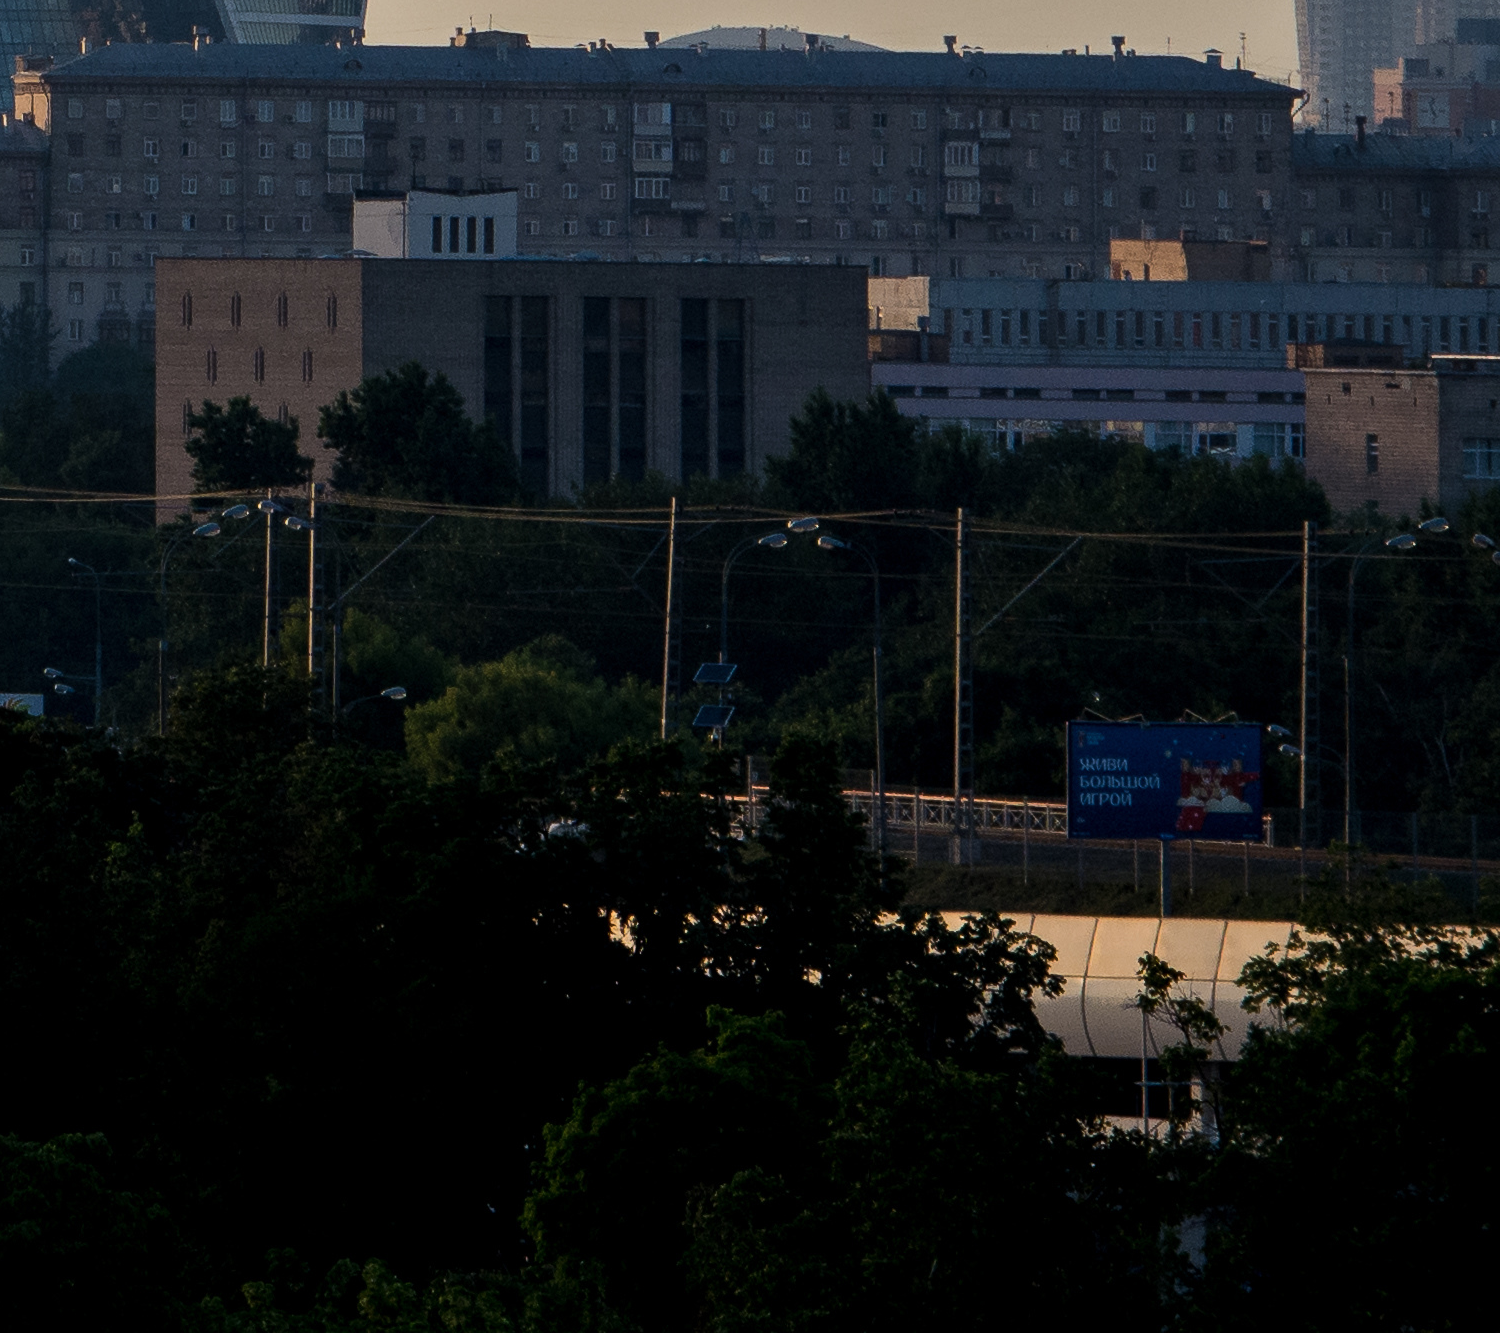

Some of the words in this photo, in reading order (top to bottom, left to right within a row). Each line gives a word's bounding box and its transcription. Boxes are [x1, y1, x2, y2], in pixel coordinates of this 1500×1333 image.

[1079, 757, 1128, 772] ЖИВИ
[1079, 772, 1160, 789] БОЛЬШОЙ
[1080, 789, 1133, 807] ИГРОЙ
